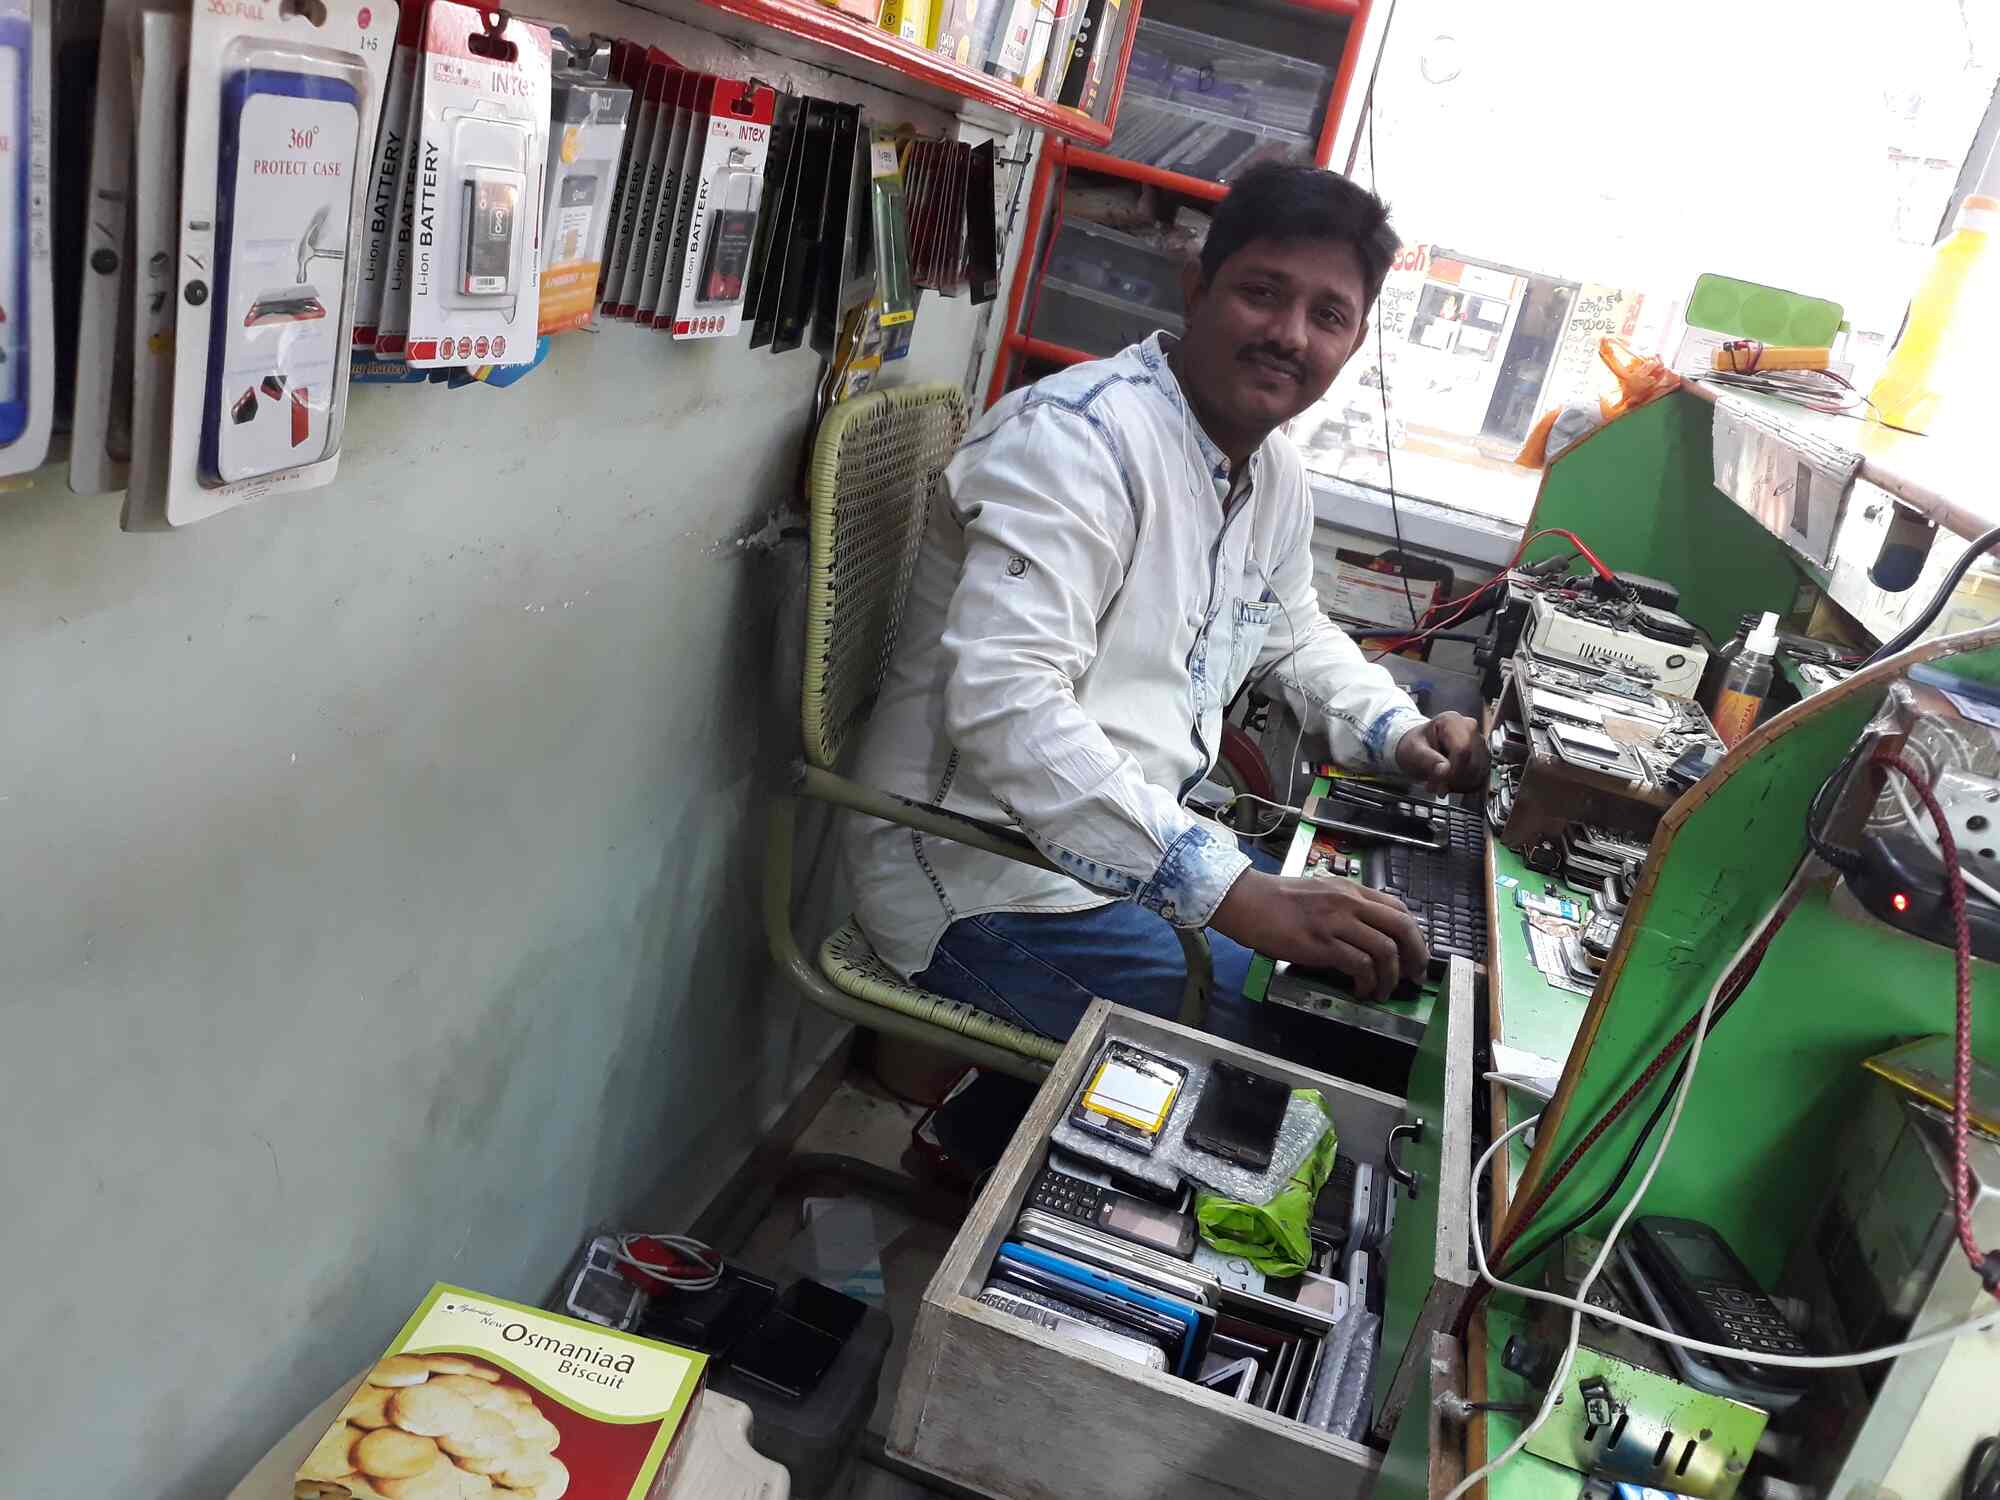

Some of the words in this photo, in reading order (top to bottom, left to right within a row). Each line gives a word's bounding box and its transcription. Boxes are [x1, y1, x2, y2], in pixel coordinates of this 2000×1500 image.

[253, 159, 307, 176] PROTECT
[313, 160, 342, 177] CASE
[371, 131, 401, 234] BATTERY
[420, 141, 440, 247] BATTERY
[621, 160, 642, 235] BATTERY
[654, 167, 675, 243] BATTERY
[673, 173, 692, 249] BATTERY
[690, 177, 710, 254] BATTERY
[418, 252, 430, 296] Li-ion
[502, 1323, 636, 1374] Osmaniaa
[558, 1359, 625, 1390] Biscuit
